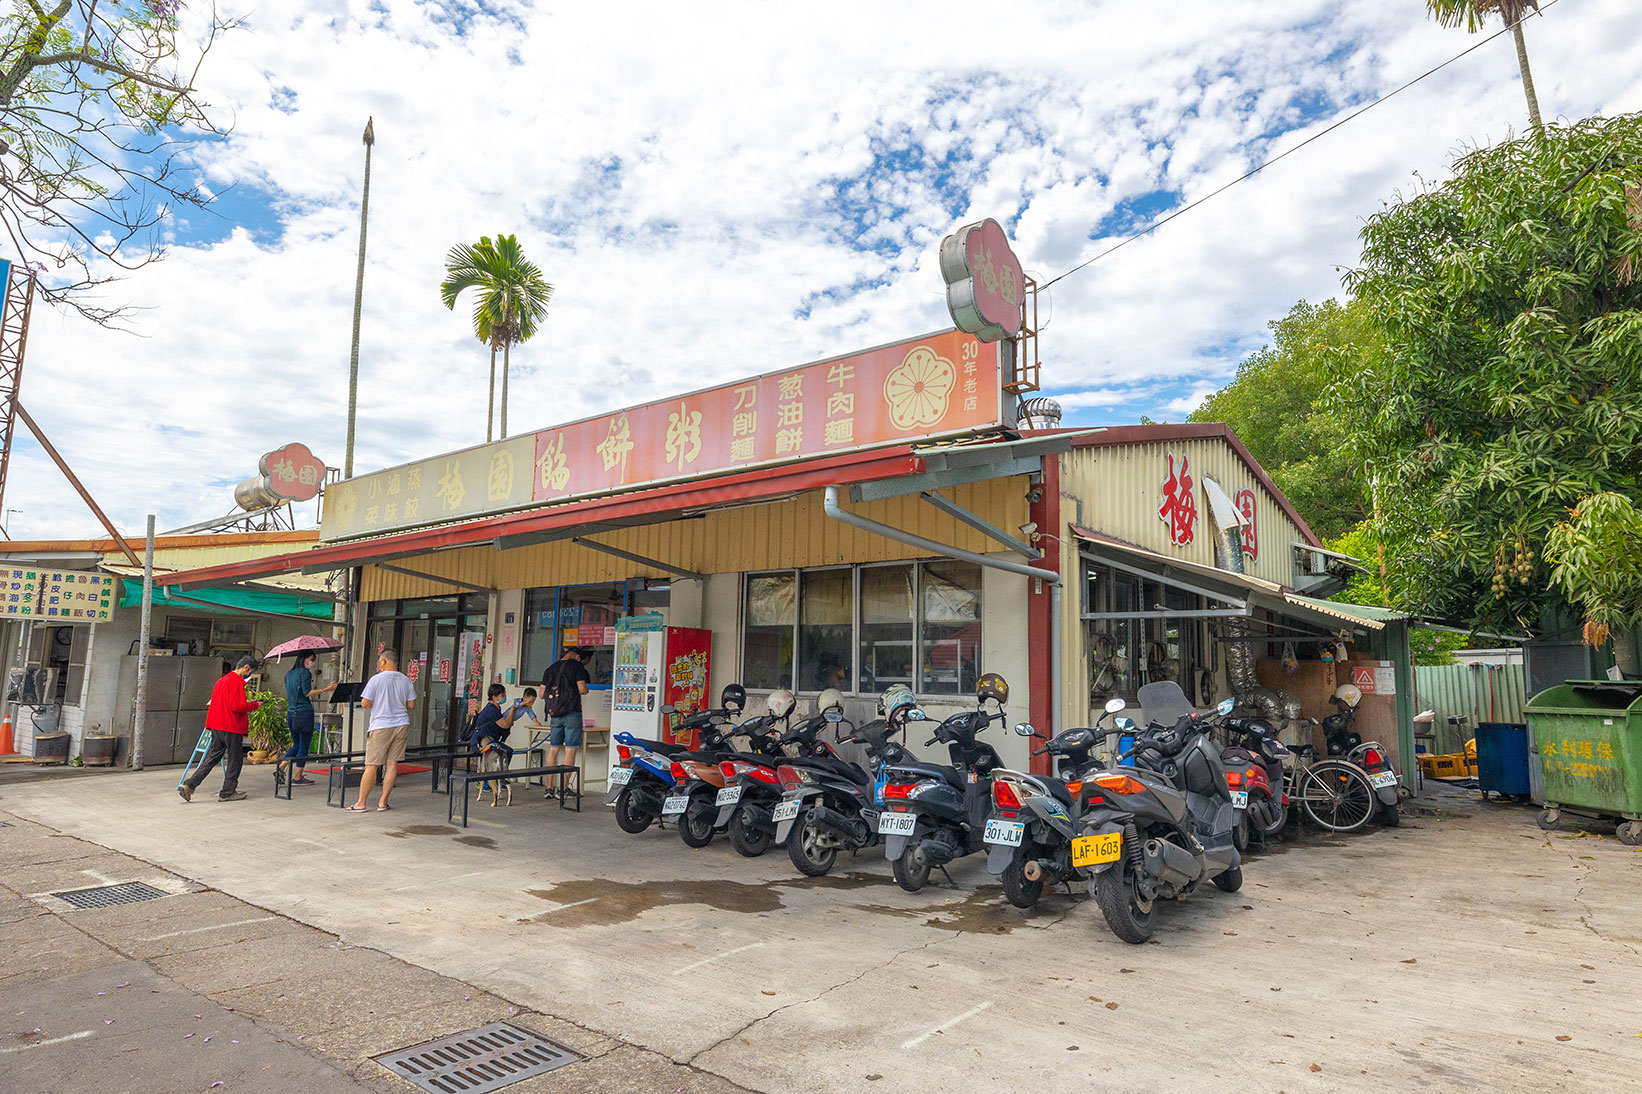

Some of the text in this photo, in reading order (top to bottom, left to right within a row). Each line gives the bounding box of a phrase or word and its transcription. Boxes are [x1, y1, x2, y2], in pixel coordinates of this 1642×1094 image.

[973, 242, 1018, 308] 梅園
[824, 363, 856, 447] 牛肉麵
[961, 340, 979, 412] 30年老店
[730, 385, 757, 464] 刀削麵
[272, 457, 318, 486] 梅園
[436, 449, 514, 511] 梅園
[87, 576, 100, 618] 黑白切
[985, 827, 1021, 843] 301-JLW
[1073, 841, 1119, 860] LAF-1603
